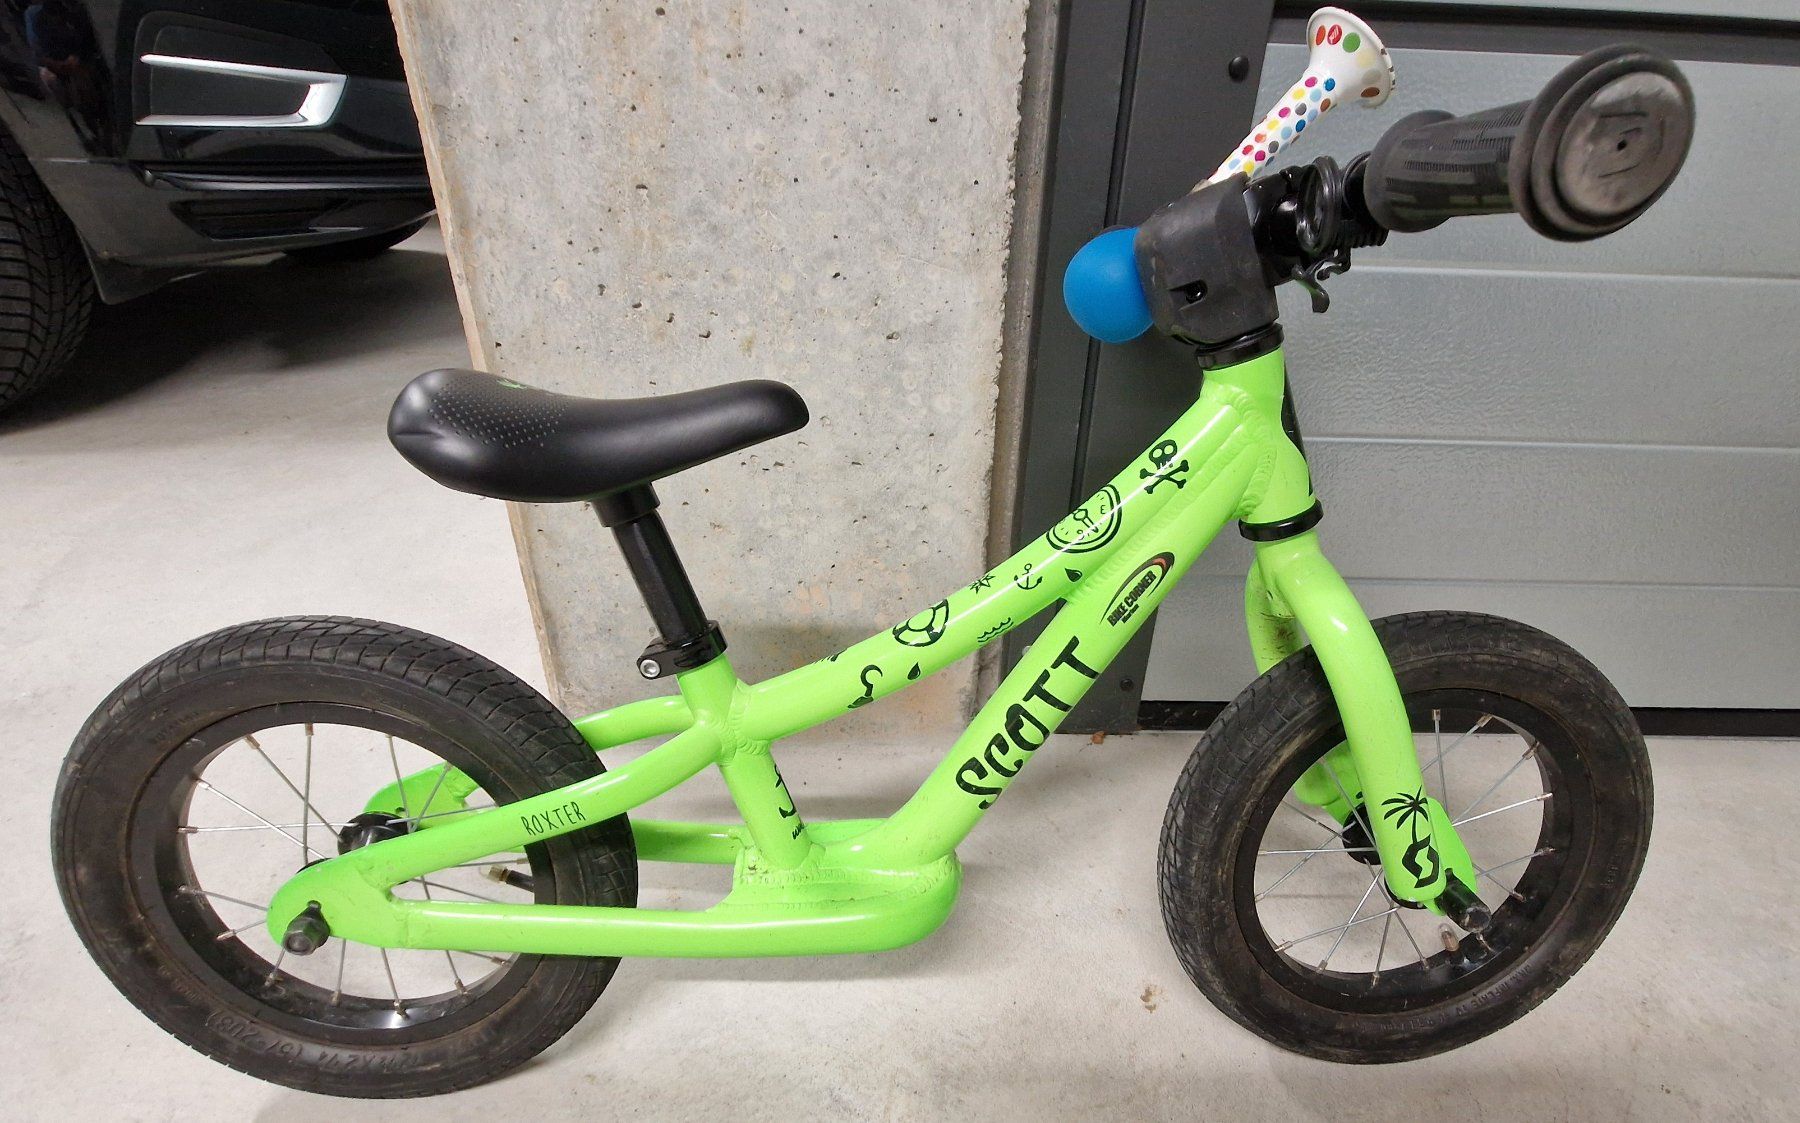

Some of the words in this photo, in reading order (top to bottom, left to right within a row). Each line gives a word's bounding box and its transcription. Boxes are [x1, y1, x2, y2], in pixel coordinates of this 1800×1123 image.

[1107, 602, 1129, 627] BIKE
[1123, 570, 1157, 608] CORNER
[955, 635, 1100, 810] SCOTT
[520, 801, 587, 836] ROXTER
